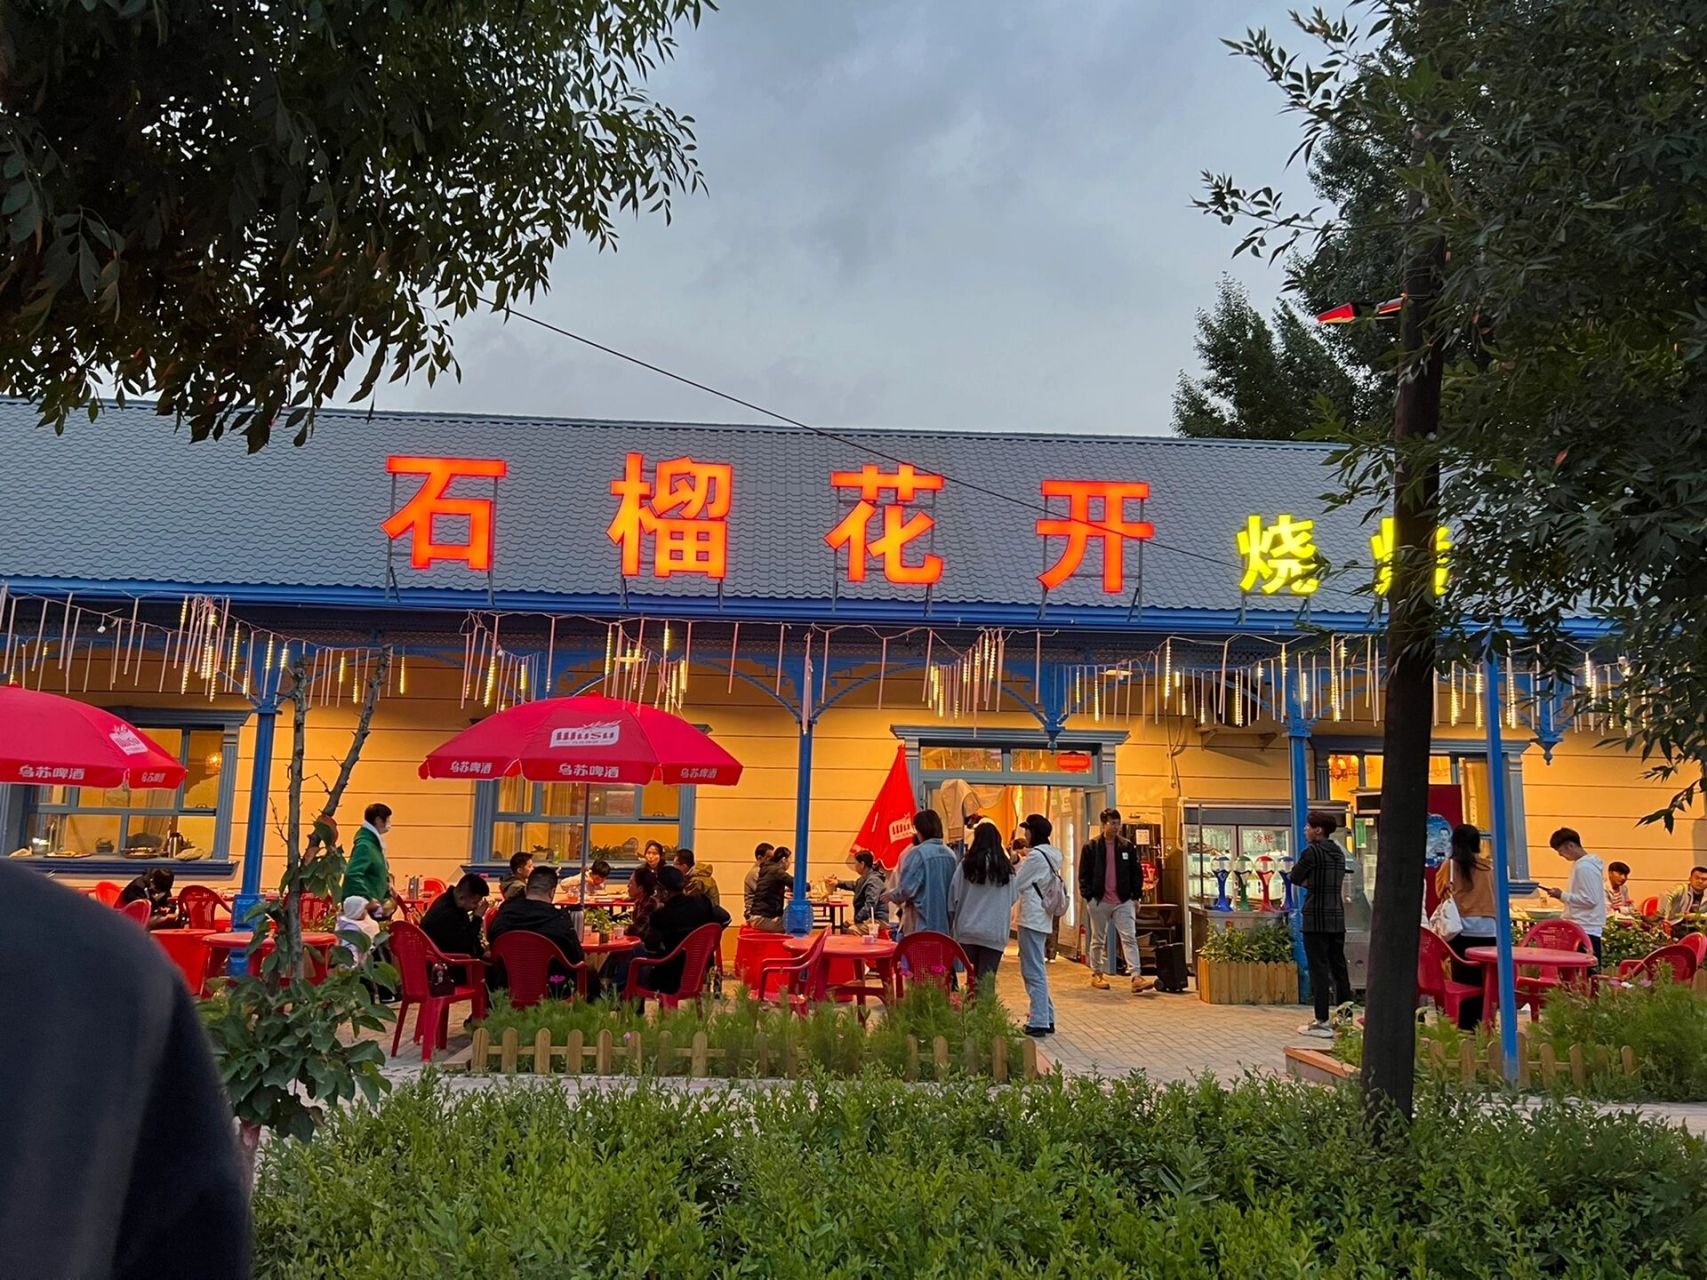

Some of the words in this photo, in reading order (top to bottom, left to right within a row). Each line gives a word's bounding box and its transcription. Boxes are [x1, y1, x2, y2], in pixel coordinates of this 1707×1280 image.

[380, 451, 1155, 594] 石榴花开
[19, 764, 85, 780] 乌苏啤酒
[449, 760, 493, 774] 乌苏啤酒
[558, 762, 619, 778] 乌苏啤酒
[680, 767, 718, 779] 乌苏啤酒
